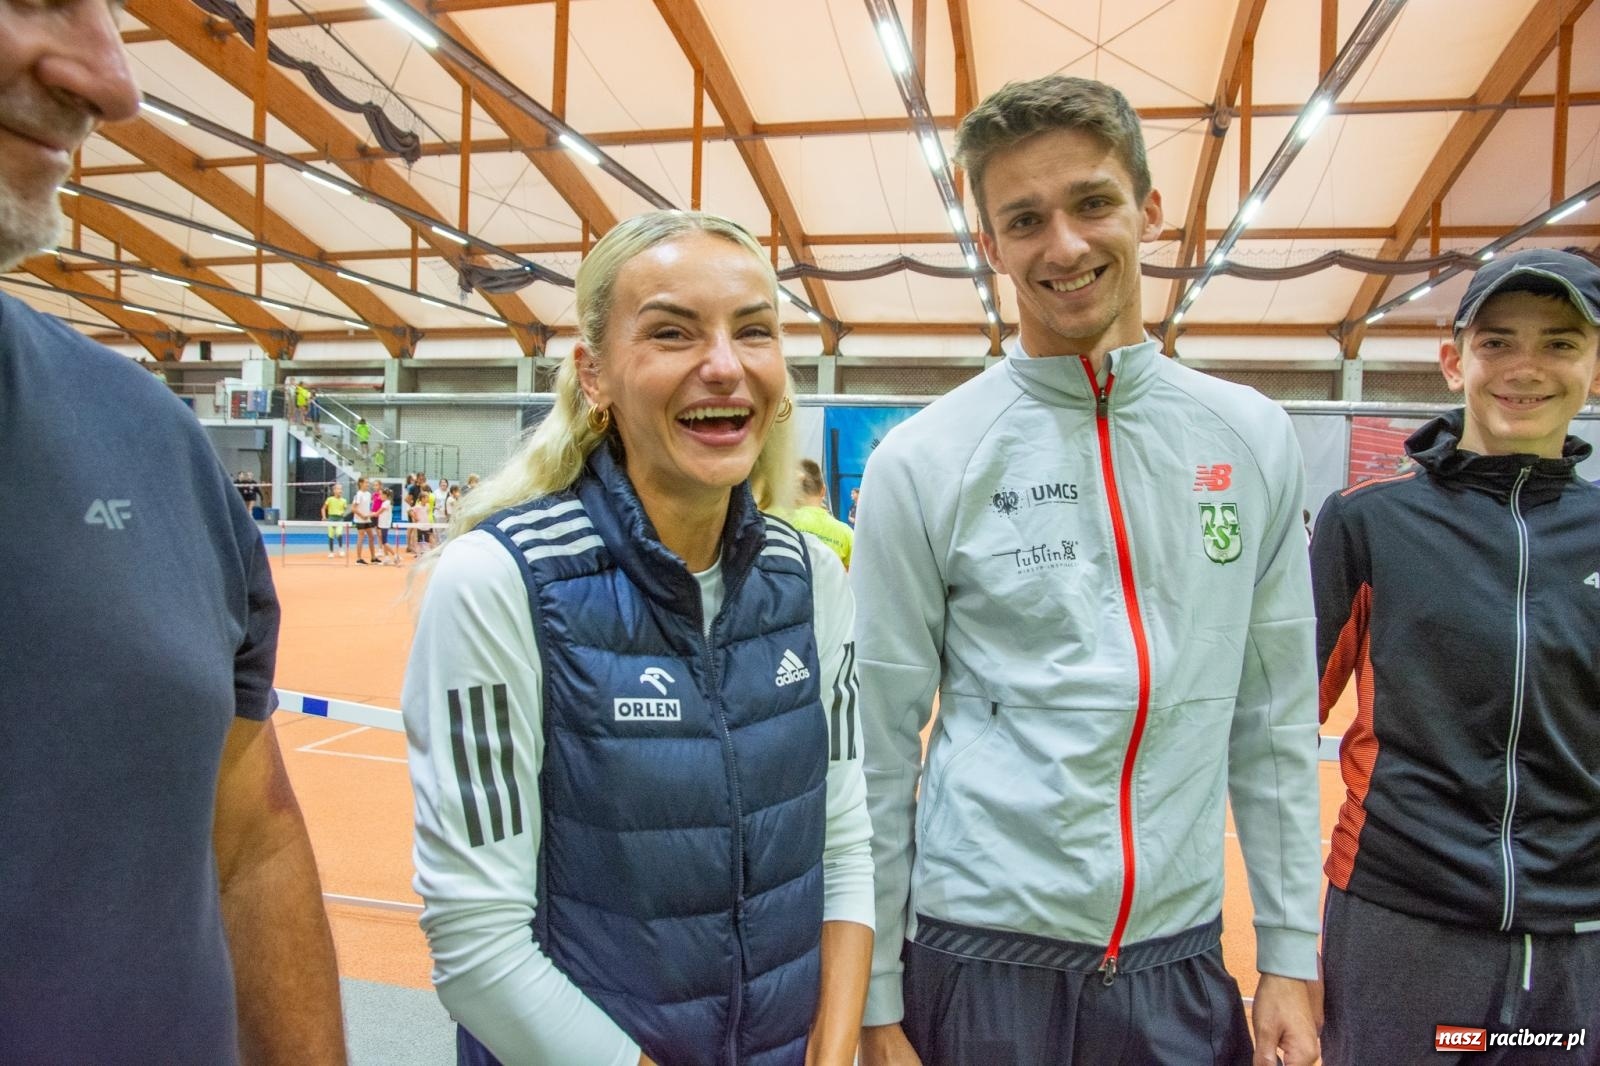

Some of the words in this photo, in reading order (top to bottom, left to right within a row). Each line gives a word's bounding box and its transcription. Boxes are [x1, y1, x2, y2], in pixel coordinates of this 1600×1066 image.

[1031, 484, 1078, 501] UMCS
[84, 499, 131, 530] 4F
[775, 667, 810, 687] adidas
[618, 702, 678, 718] ORLEN
